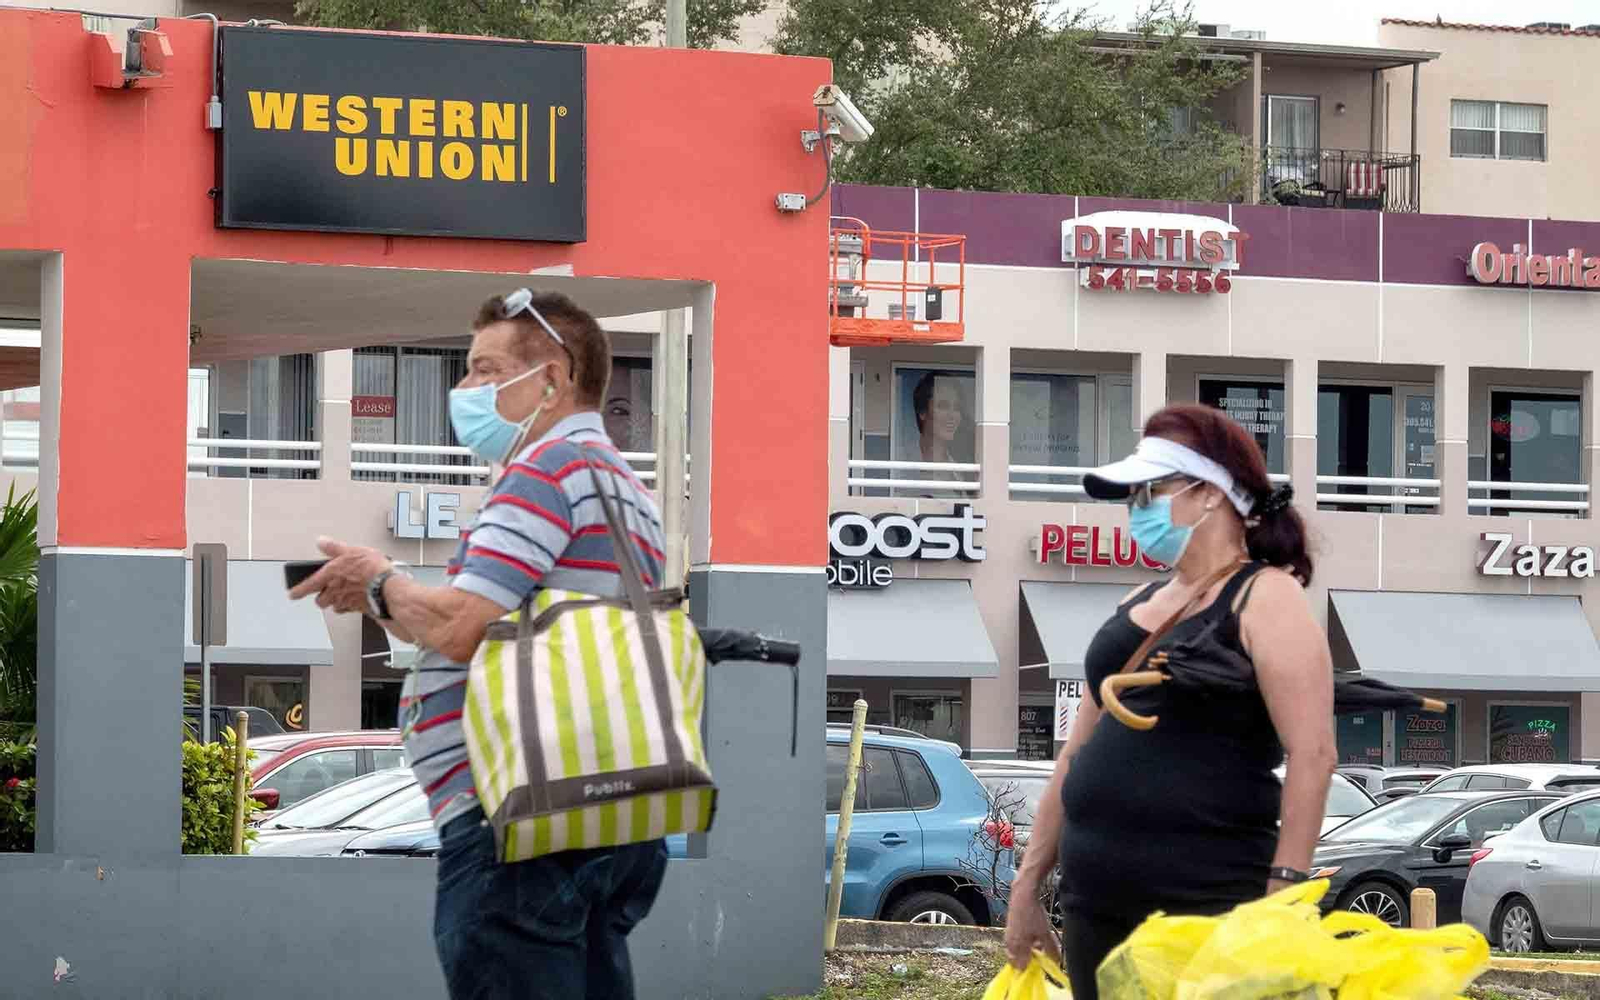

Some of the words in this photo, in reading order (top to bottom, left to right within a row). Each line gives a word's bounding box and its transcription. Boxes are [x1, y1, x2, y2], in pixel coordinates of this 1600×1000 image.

[247, 91, 516, 140] WESTERN
[335, 137, 516, 182] UNION
[1074, 225, 1249, 266] DENTIST
[1471, 241, 1600, 288] Orienta
[1086, 266, 1232, 294] 541-5556
[356, 399, 392, 413] Lease
[396, 491, 461, 539] LE
[1040, 524, 1171, 569] PELU
[1480, 532, 1595, 578] Zaza
[1020, 711, 1037, 721] 807
[1406, 714, 1447, 732] Zaza
[1528, 719, 1557, 732] PIZZA
[1501, 746, 1555, 761] CUBANO
